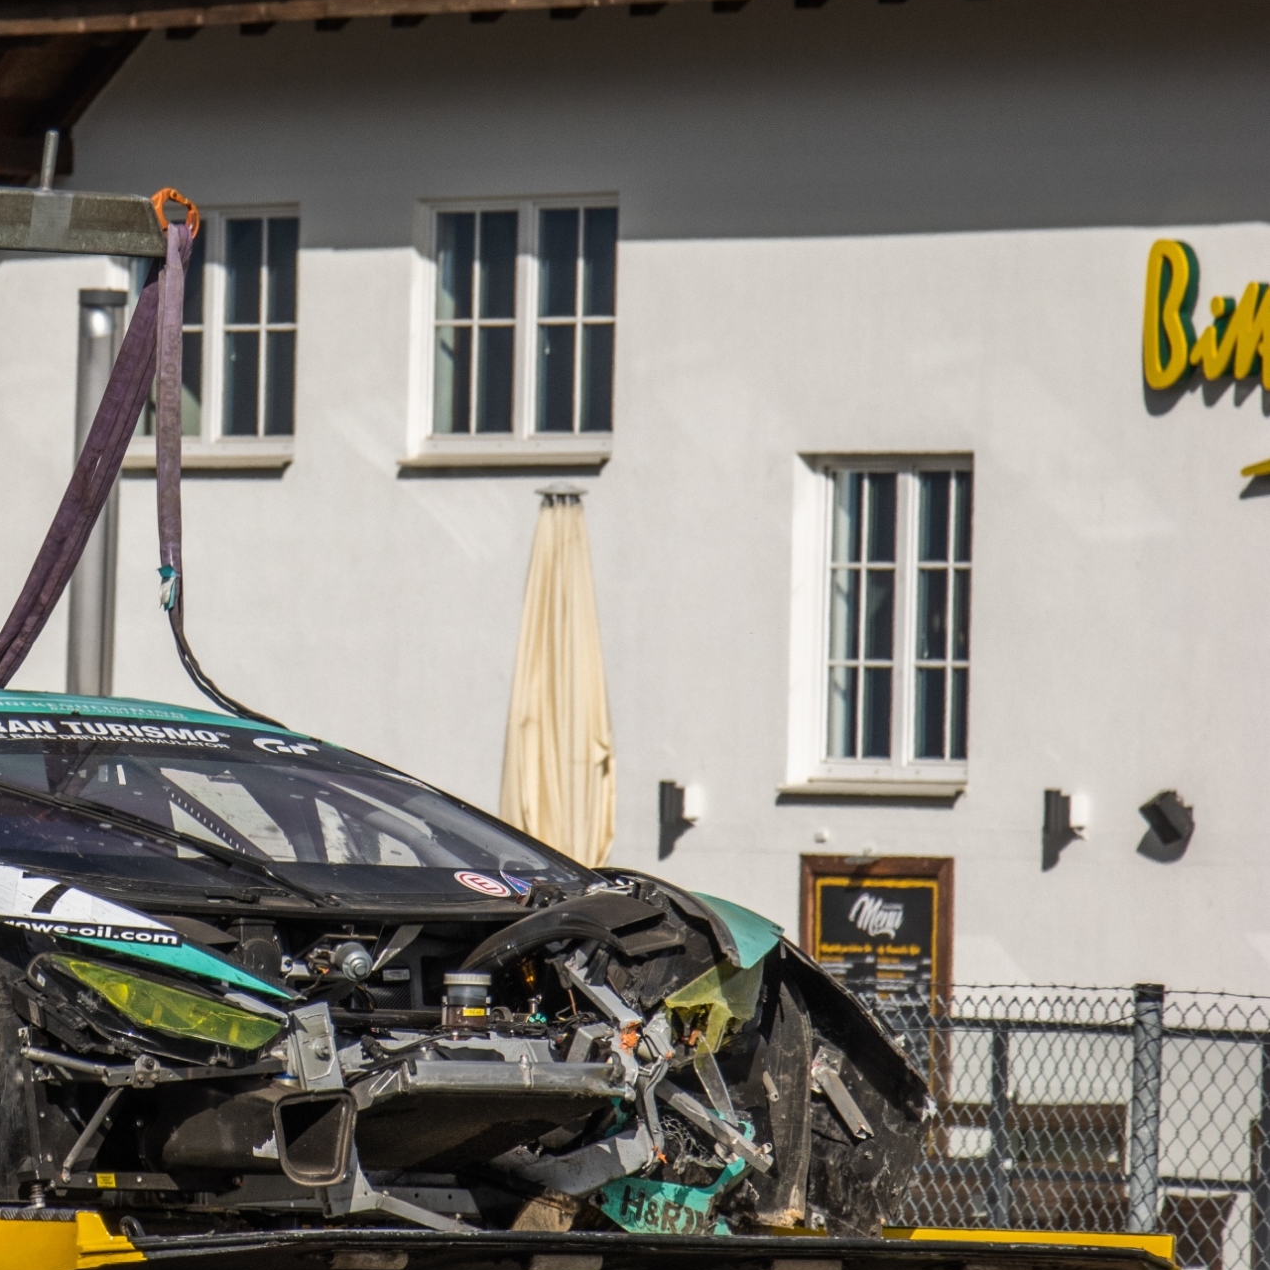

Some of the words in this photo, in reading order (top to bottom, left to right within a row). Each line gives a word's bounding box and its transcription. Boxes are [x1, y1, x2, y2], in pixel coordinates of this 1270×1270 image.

[58, 733, 130, 743] DRIVING
[132, 735, 231, 750] SIMULATOR
[847, 892, 905, 940] Menu
